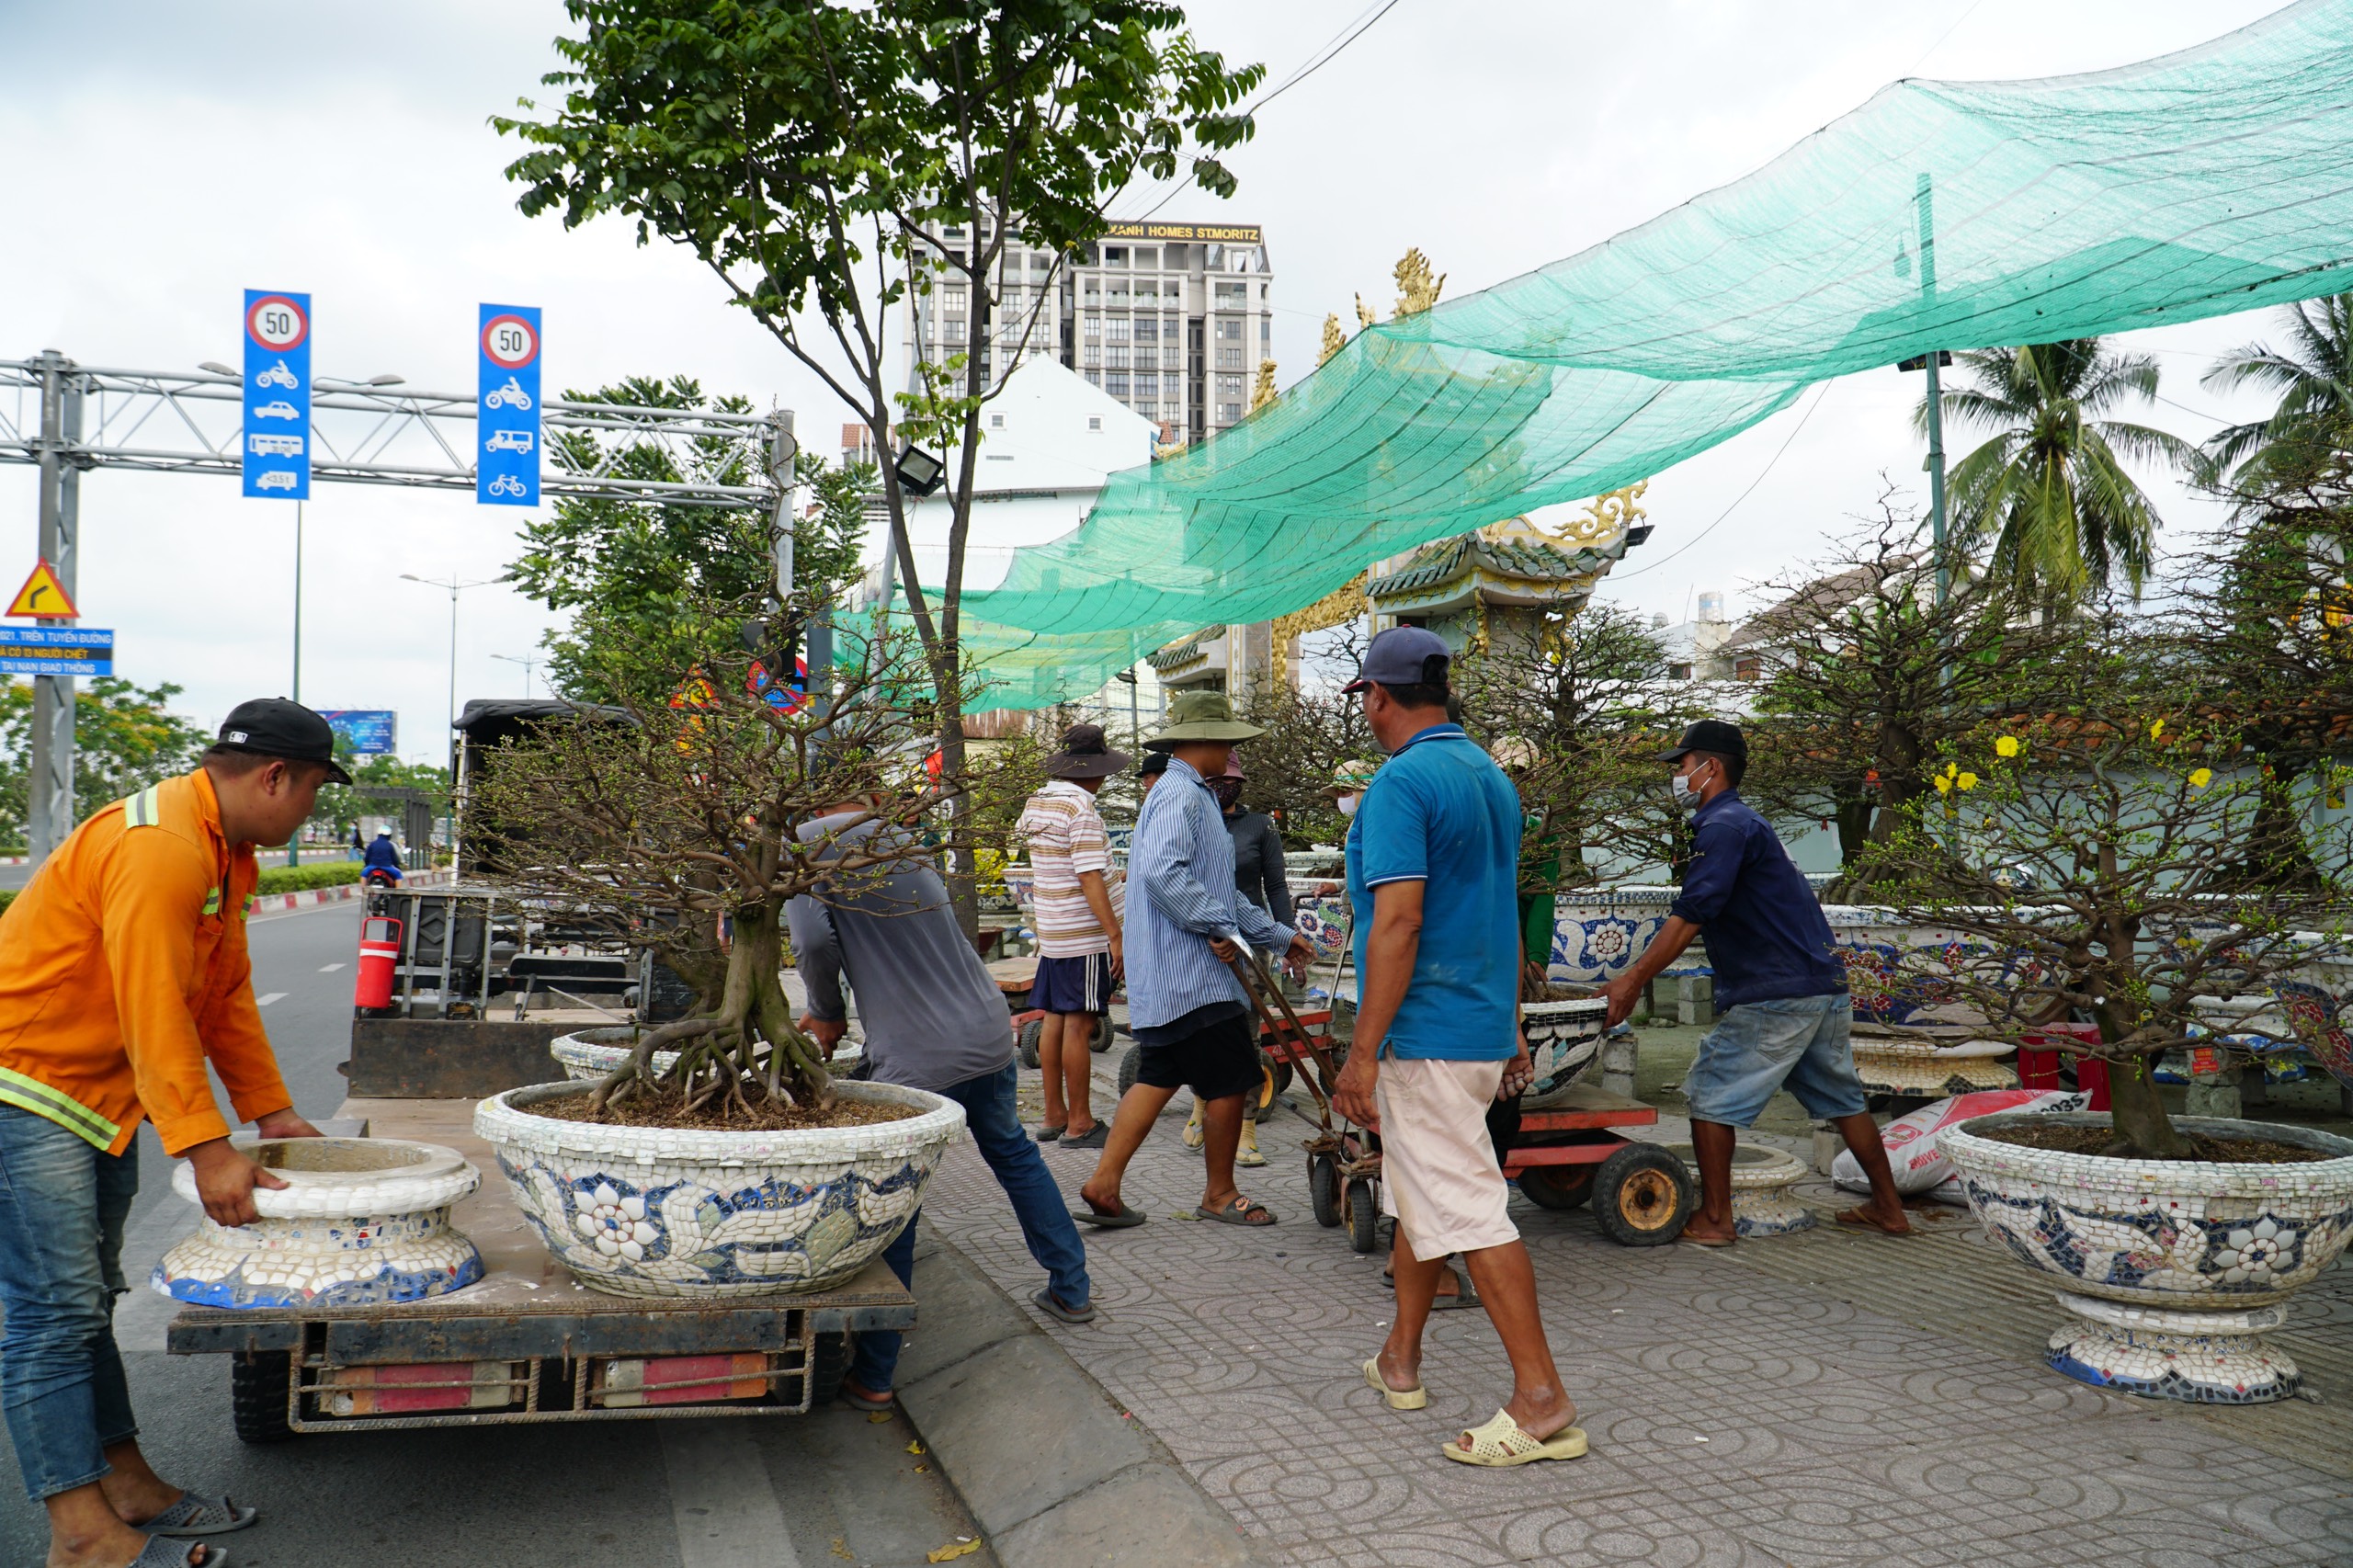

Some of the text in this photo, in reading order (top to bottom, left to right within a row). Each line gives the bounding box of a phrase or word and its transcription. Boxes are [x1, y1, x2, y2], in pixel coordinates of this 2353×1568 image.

[1148, 226, 1193, 238] HOMES
[267, 312, 289, 335] 50
[500, 330, 521, 352] 50
[20, 630, 45, 642] TRÊN
[48, 631, 77, 642] TUYẾN
[8, 645, 21, 657] CÓ
[64, 647, 88, 659] CHẾT
[2, 661, 96, 673] TAI NẠN GIAO THÔNG
